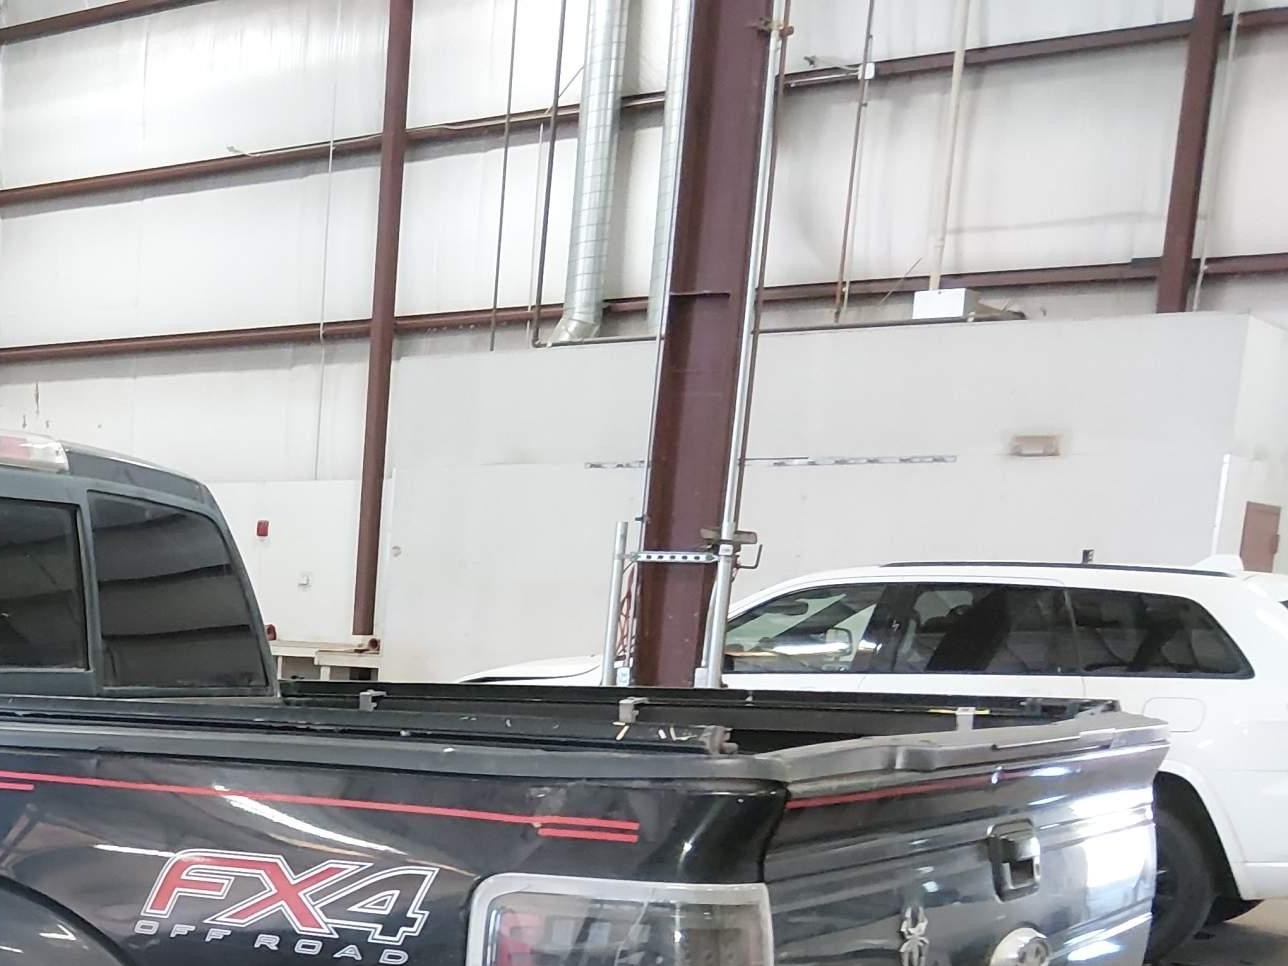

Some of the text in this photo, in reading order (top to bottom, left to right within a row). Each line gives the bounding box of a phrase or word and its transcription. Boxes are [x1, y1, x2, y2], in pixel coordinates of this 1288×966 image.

[140, 848, 440, 945] FX4
[134, 919, 409, 966] OFF ROAD
